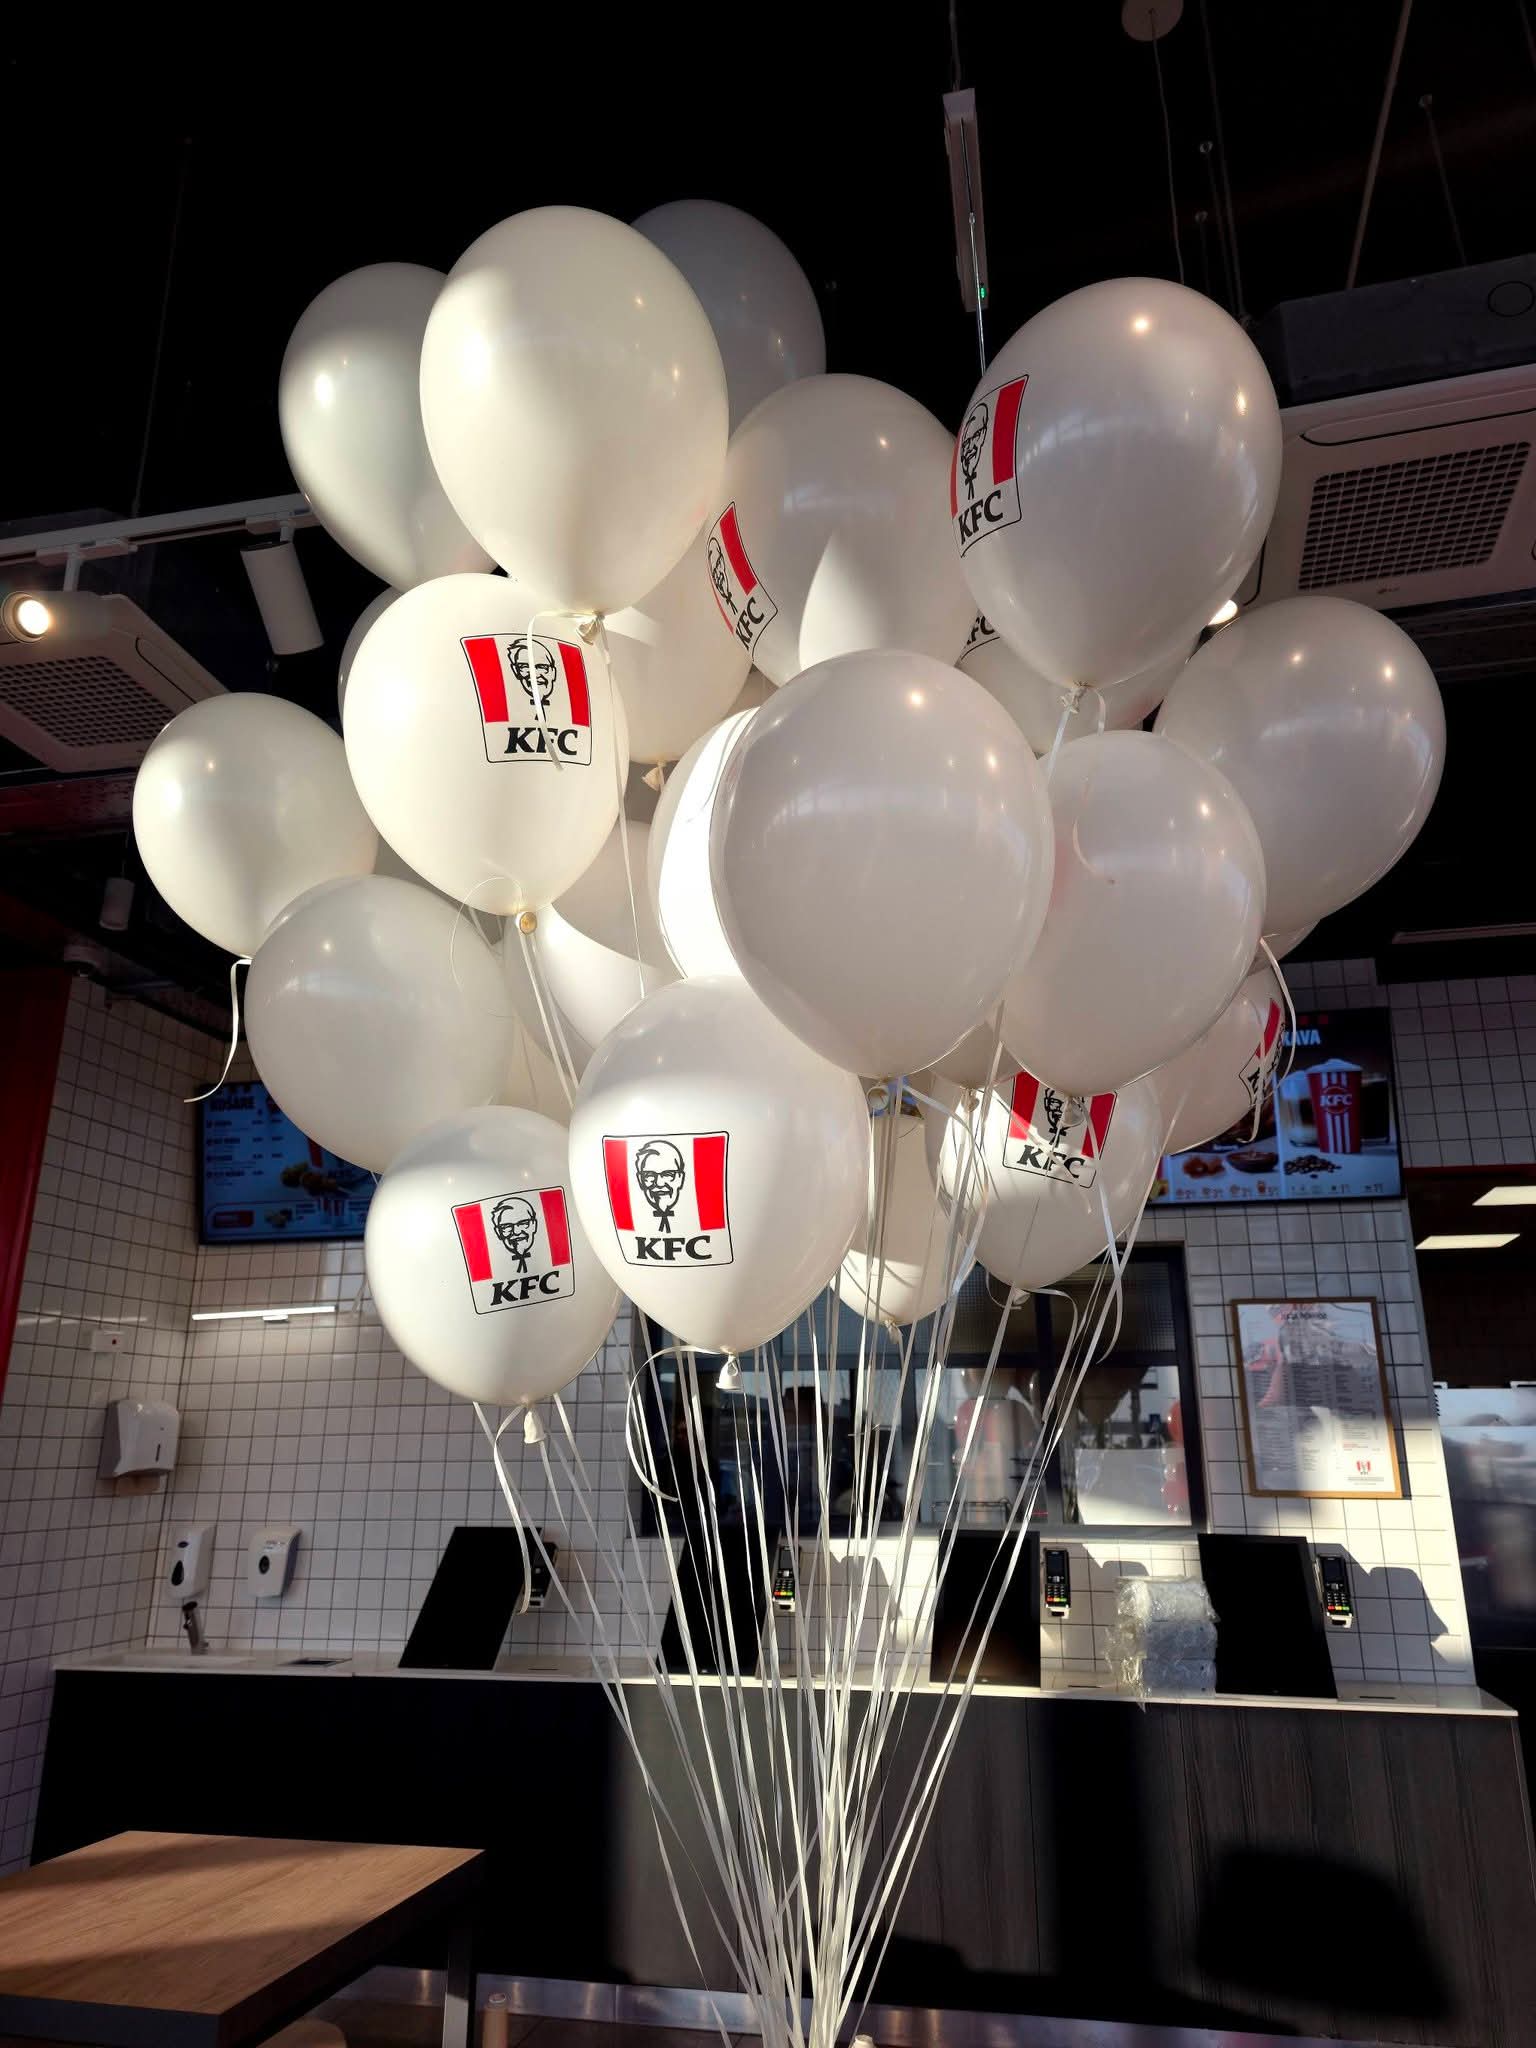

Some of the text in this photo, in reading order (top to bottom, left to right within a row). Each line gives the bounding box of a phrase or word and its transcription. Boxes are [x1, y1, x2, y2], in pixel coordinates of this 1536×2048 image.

[958, 490, 1003, 545] KFC
[735, 597, 765, 651] KFC
[966, 615, 996, 646] FC
[504, 727, 578, 755] KFC
[1319, 1093, 1352, 1107] KFC
[1017, 1144, 1085, 1178] KFC
[635, 1235, 712, 1260] KFC
[490, 1270, 560, 1306] KFC
